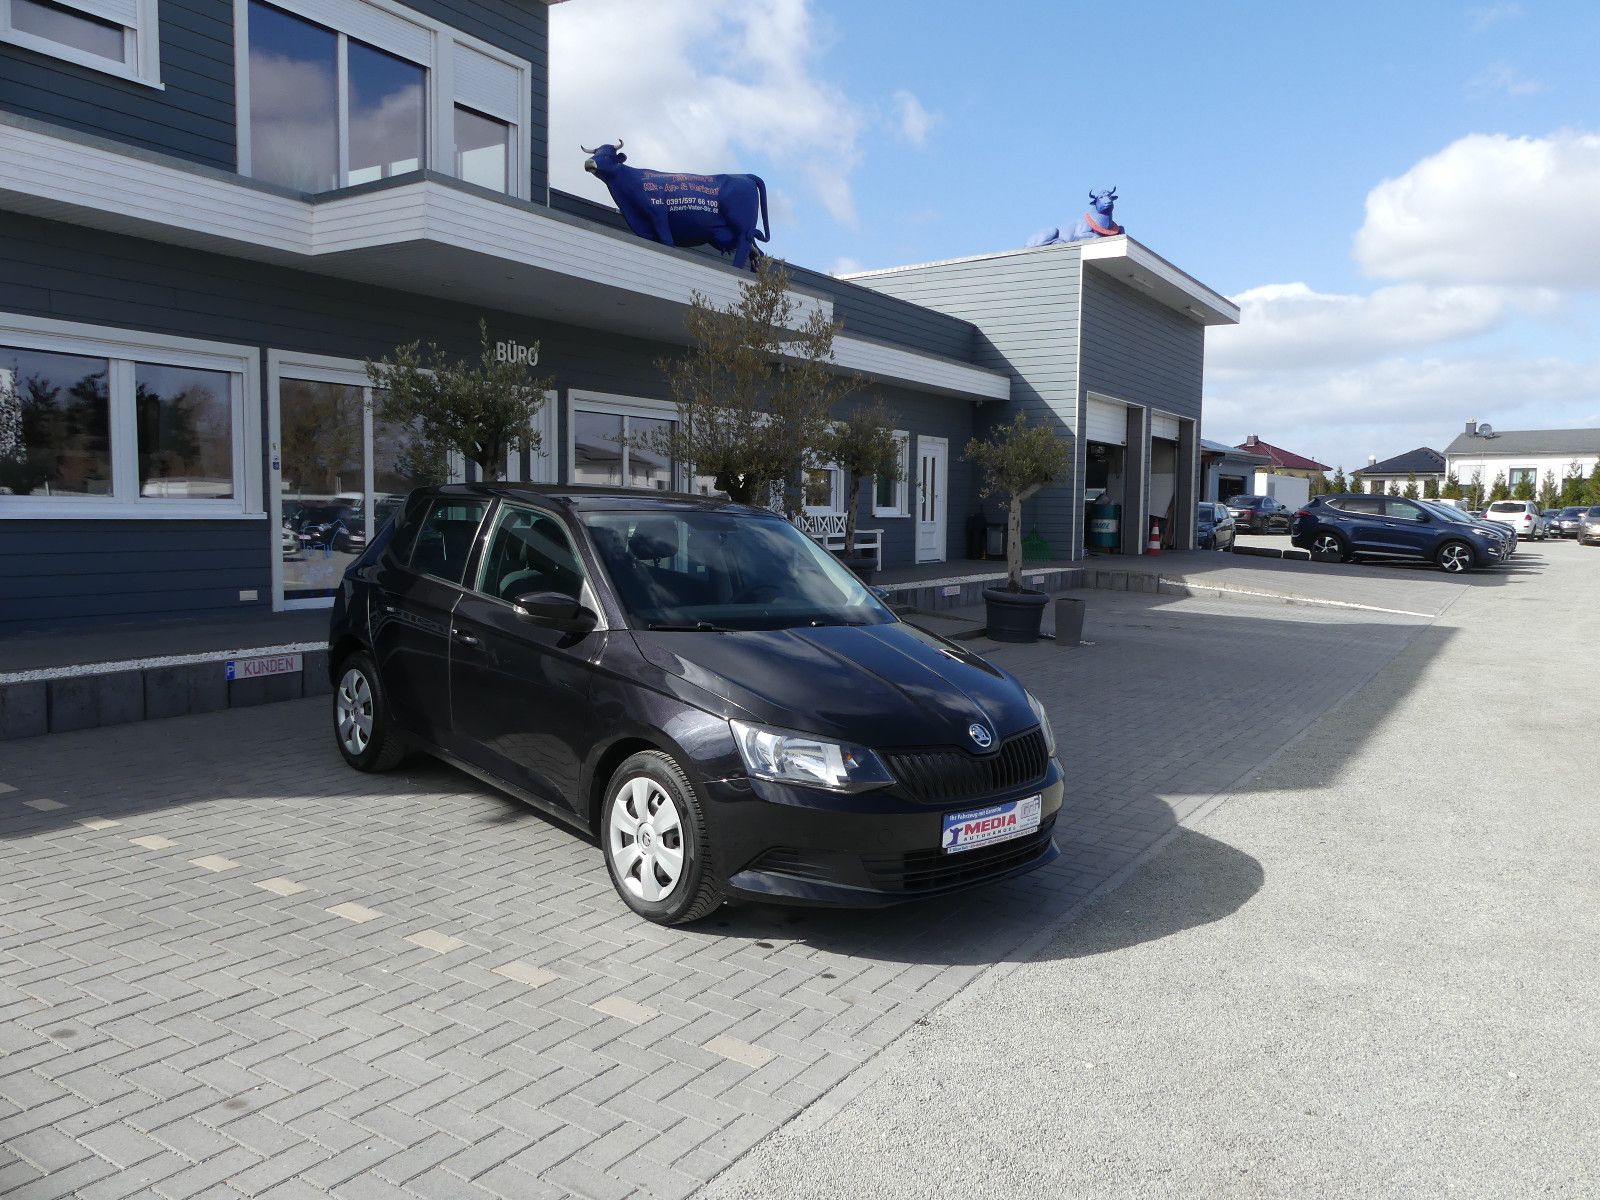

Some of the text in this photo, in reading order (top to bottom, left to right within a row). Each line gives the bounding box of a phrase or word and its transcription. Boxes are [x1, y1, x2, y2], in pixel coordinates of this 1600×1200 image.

[651, 198, 664, 206] Tel.
[666, 197, 697, 206] 0391/597
[707, 200, 719, 208] 100
[496, 339, 539, 367] BÜRO
[226, 656, 294, 677] P KUNDEN
[964, 813, 1017, 836] MEDIA
